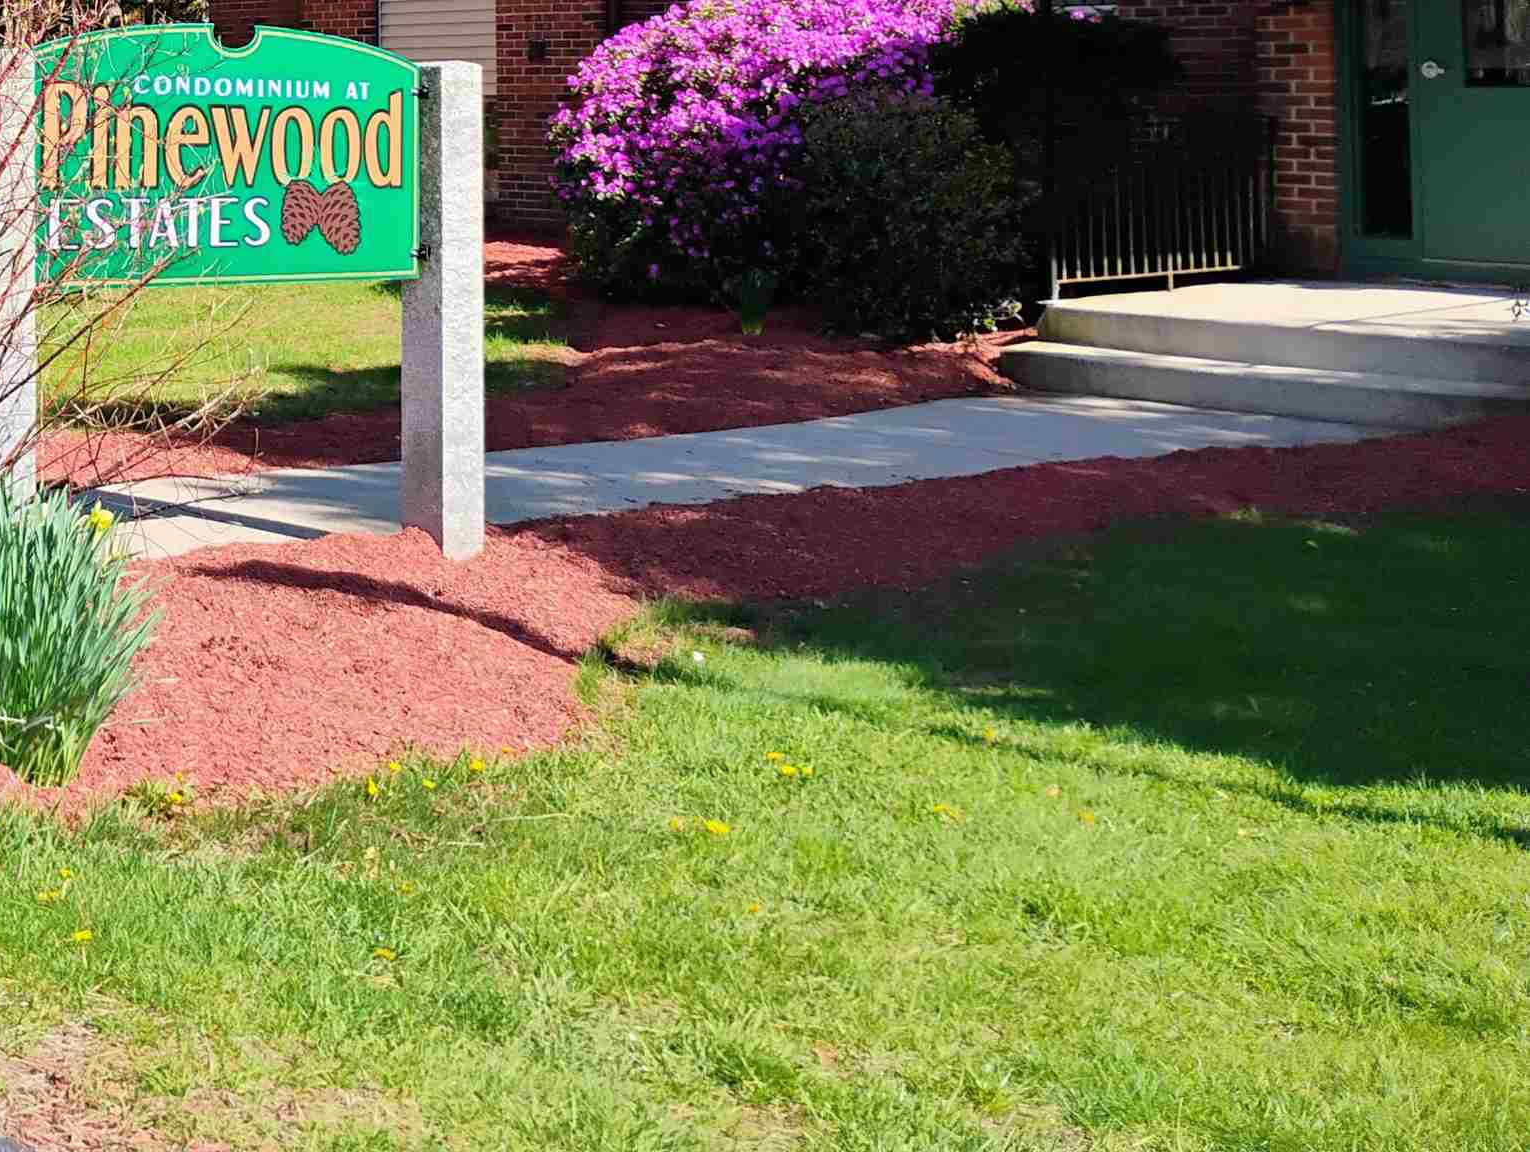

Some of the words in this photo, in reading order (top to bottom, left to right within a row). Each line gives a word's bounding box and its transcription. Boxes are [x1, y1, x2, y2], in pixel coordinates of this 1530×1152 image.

[133, 74, 331, 100] CONDOMINIUM
[344, 81, 371, 100] AT
[38, 80, 403, 191] Pinewood
[47, 196, 271, 250] ESTATES
